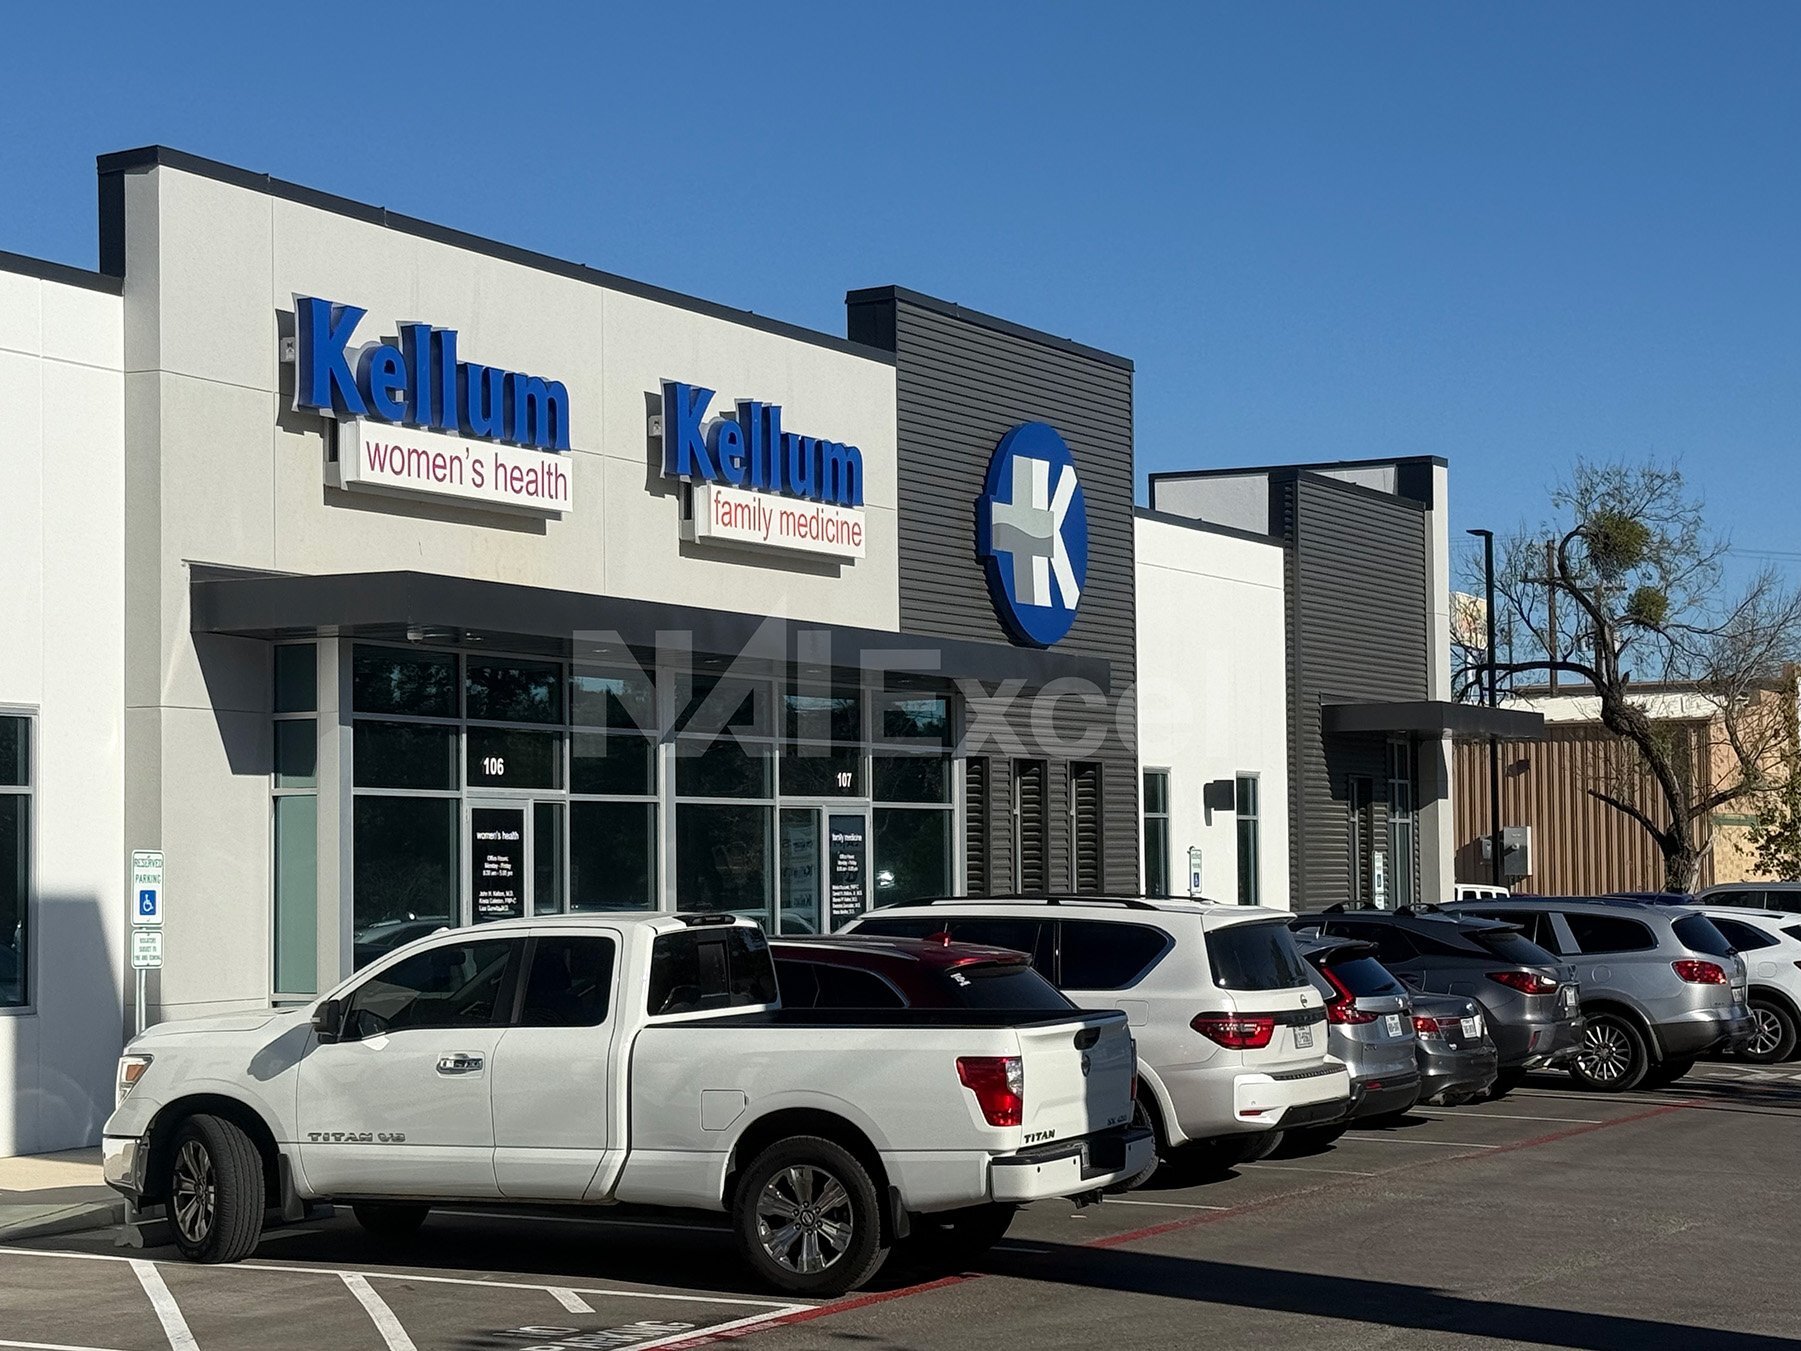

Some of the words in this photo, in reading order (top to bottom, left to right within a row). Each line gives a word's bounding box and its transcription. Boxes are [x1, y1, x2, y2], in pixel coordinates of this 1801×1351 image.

[296, 297, 571, 451] Kellum
[661, 381, 864, 507] Kellum
[366, 441, 485, 489] women's
[494, 458, 568, 502] health
[714, 498, 772, 541] family
[780, 505, 863, 548] medicine
[483, 757, 504, 775] 106
[837, 772, 852, 788] 107
[134, 859, 162, 868] RESERVED
[136, 874, 161, 883] PARKING
[307, 1132, 373, 1142] TITAN
[1024, 1129, 1056, 1144] TITAN
